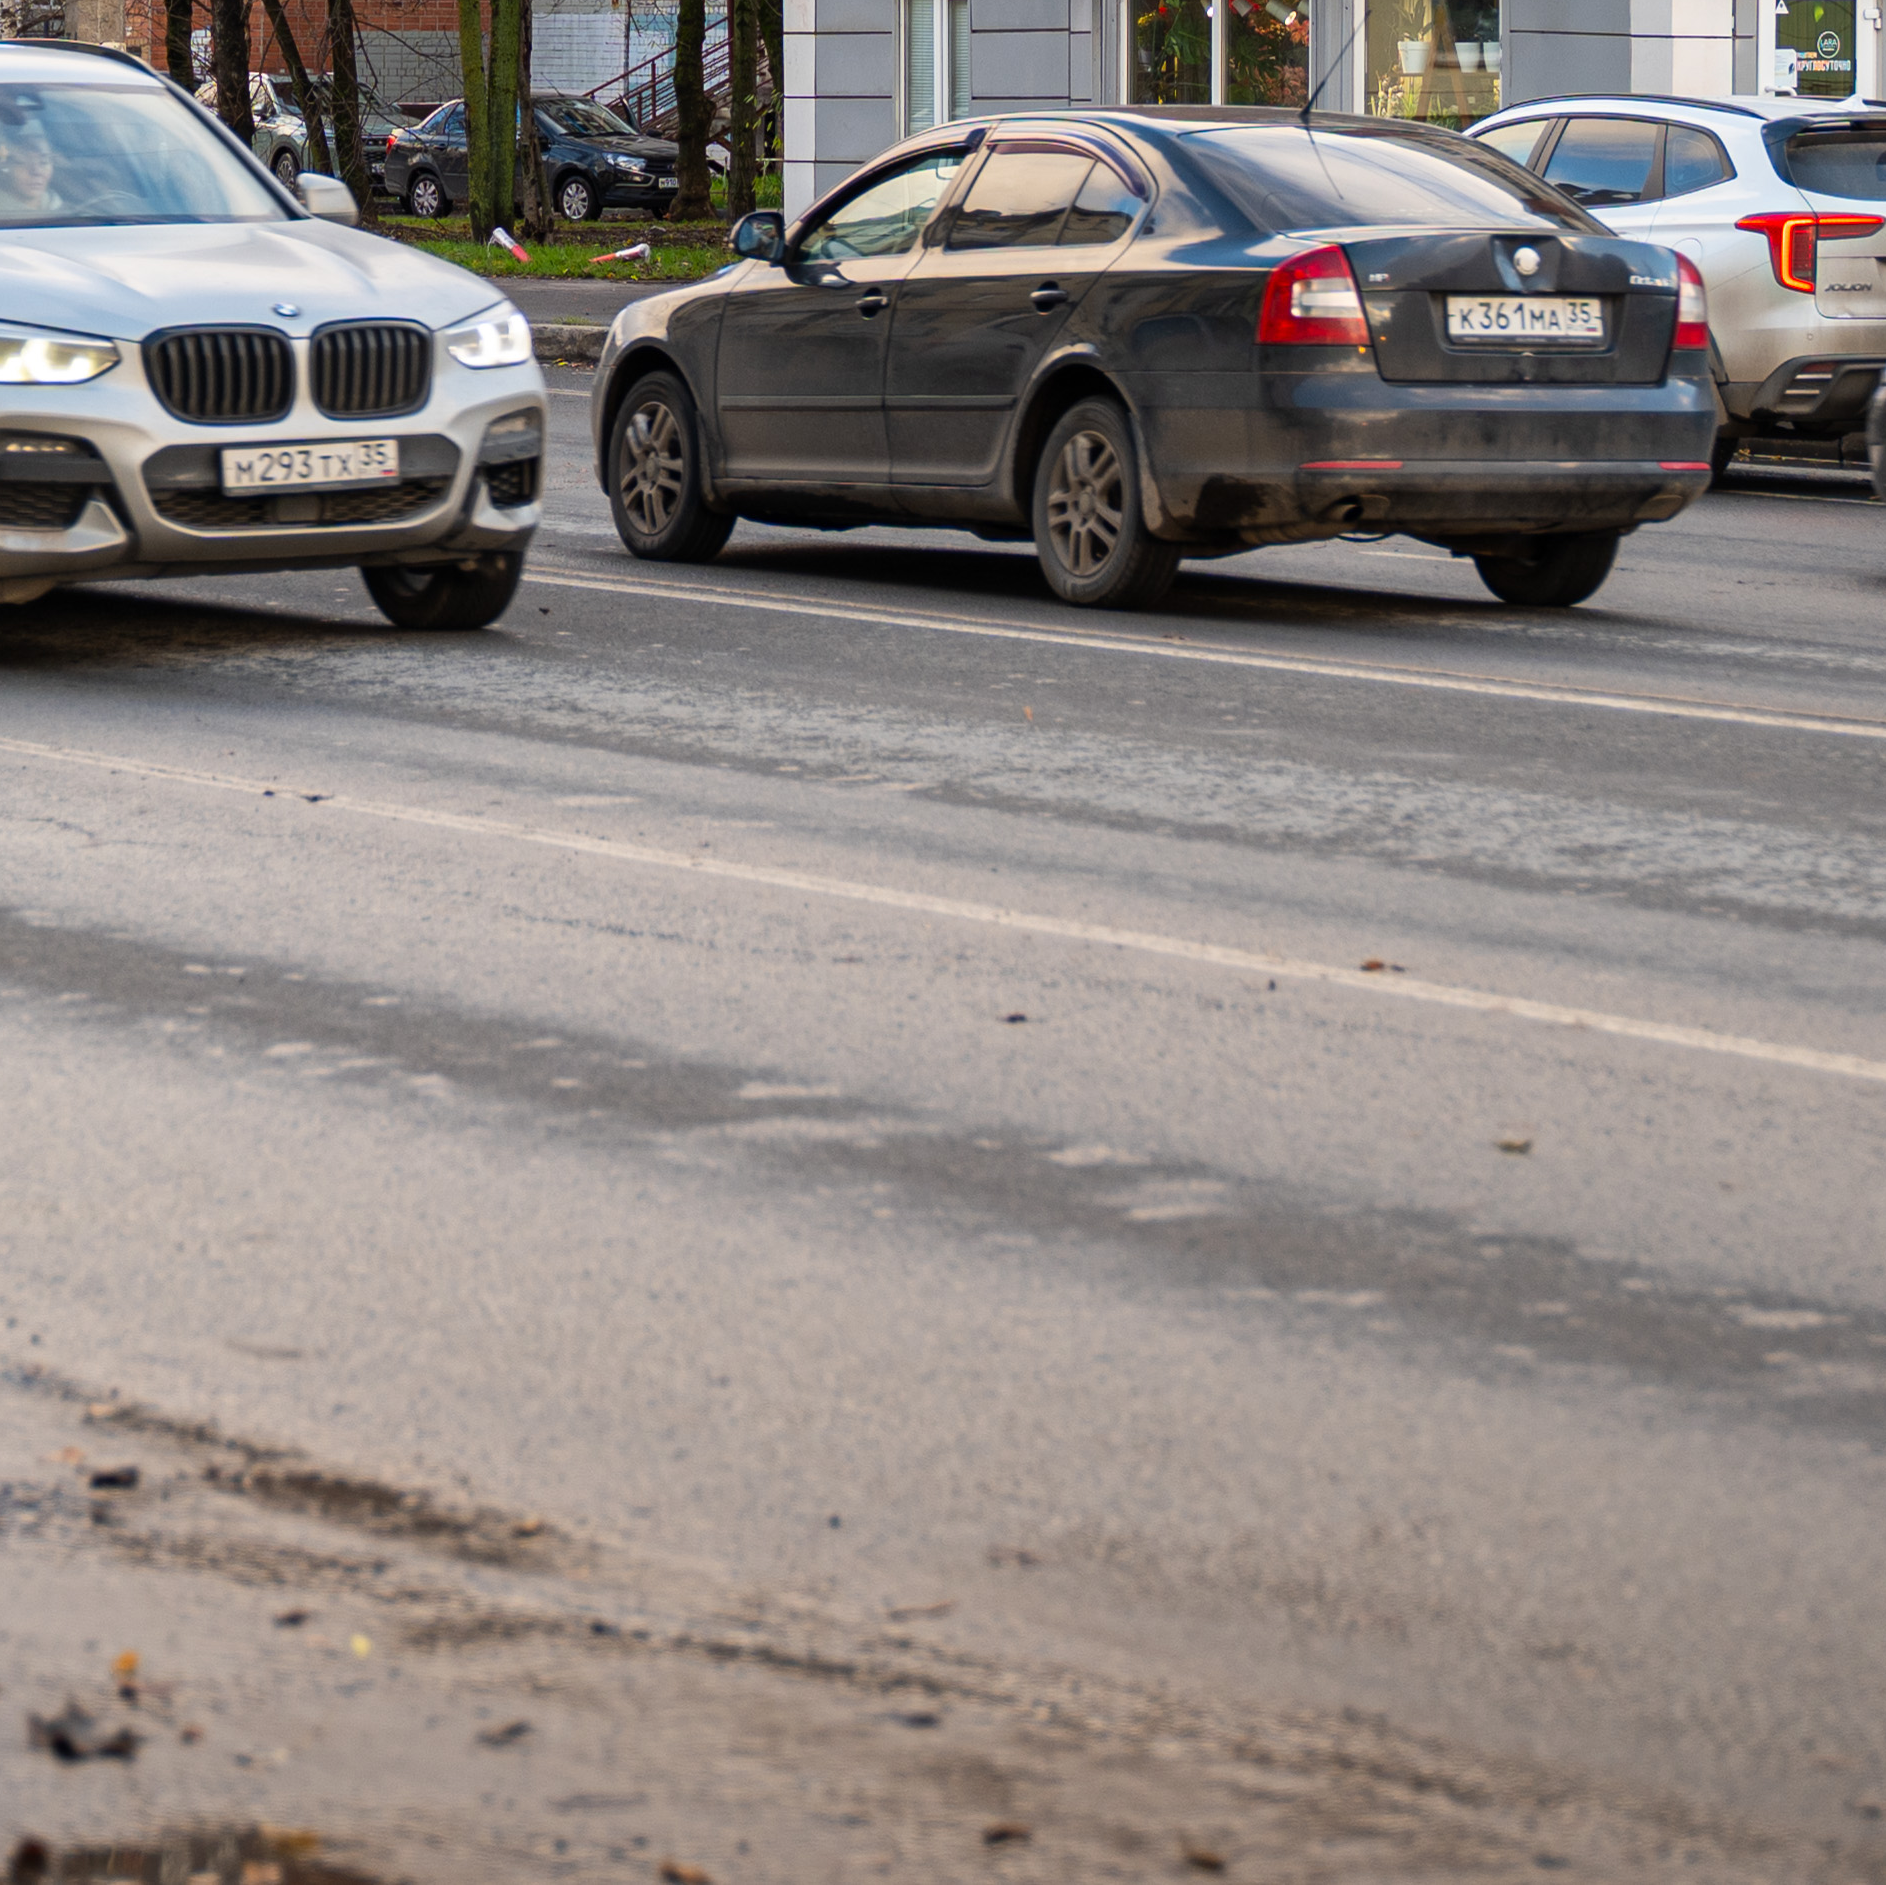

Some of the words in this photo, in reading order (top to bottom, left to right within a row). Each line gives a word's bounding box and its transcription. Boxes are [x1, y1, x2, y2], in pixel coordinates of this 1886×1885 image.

[1825, 283, 1872, 292] JOLION
[1460, 302, 1562, 330] К361МА
[1567, 302, 1592, 324] 35
[235, 450, 353, 483] М293ТХ
[360, 443, 388, 466] 35
